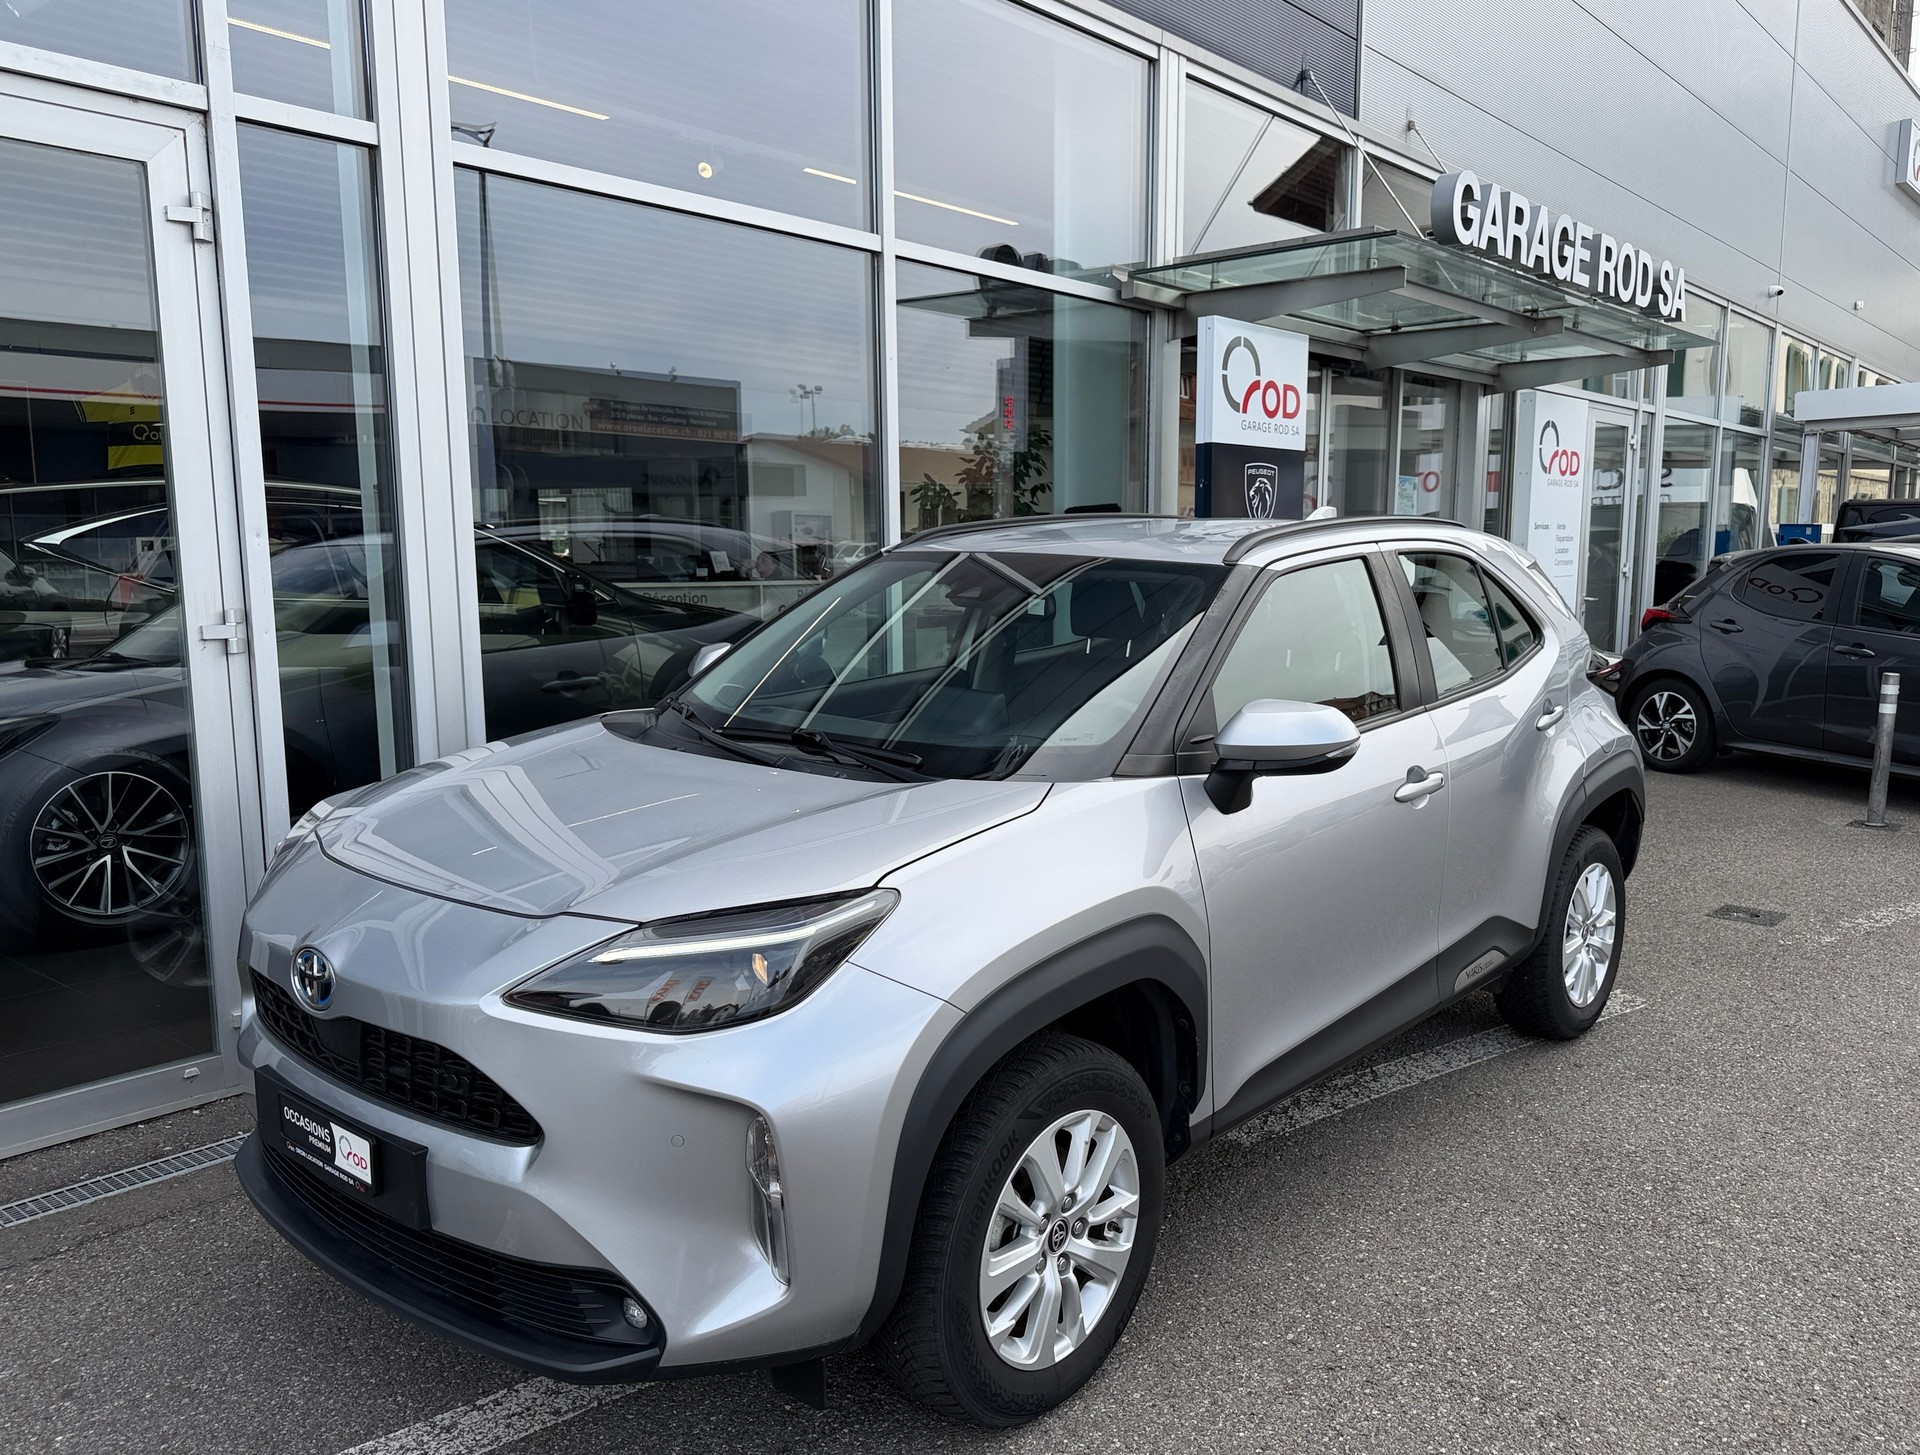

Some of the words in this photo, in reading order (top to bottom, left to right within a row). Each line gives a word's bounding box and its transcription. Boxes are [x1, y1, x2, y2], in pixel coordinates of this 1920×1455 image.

[1453, 170, 1593, 288] GARAGE
[1597, 233, 1653, 308] ROD
[1658, 260, 1686, 322] SA
[492, 408, 583, 430] LOCATION
[1241, 419, 1271, 433] GARAGE
[1273, 423, 1290, 435] ROD
[1291, 425, 1300, 436] SA
[1247, 468, 1275, 476] PEUGEOT
[284, 1106, 331, 1142] OCCASIONS
[308, 1135, 331, 1154] PREMIUM
